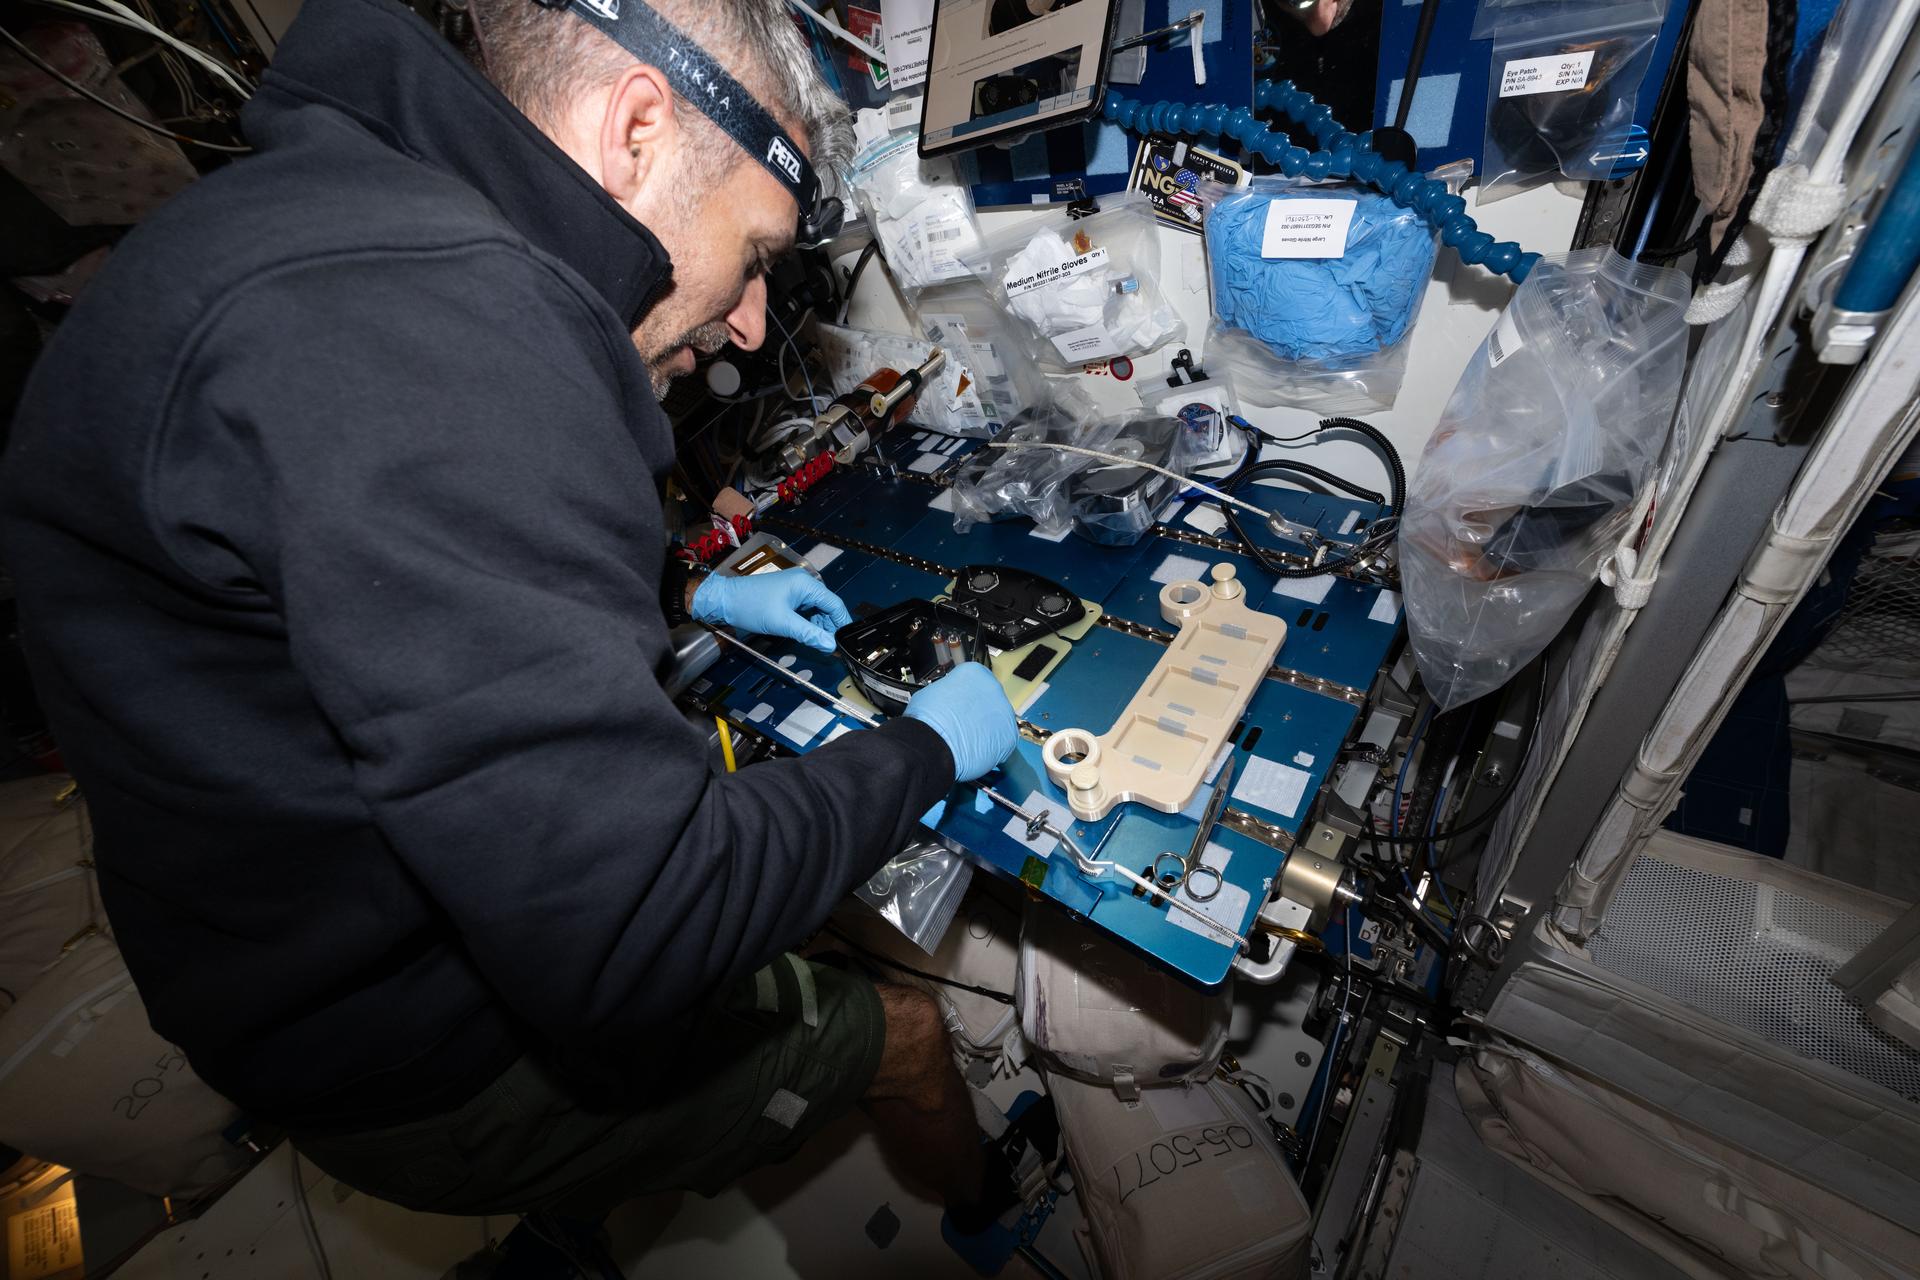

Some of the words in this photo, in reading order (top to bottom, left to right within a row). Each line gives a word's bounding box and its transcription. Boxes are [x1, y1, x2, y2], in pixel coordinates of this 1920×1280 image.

[669, 47, 730, 110] TIKKA
[1506, 70, 1518, 78] Eye
[1519, 67, 1538, 75] Patch
[1555, 78, 1570, 86] EXP
[1571, 68, 1584, 76] N/A
[767, 138, 801, 184] PETZL
[1189, 153, 1209, 165] SUPPLY
[1210, 160, 1236, 176] SERVICES
[1006, 275, 1035, 291] Medium
[1036, 266, 1059, 280] Nitrile
[1061, 256, 1088, 271] Gloves
